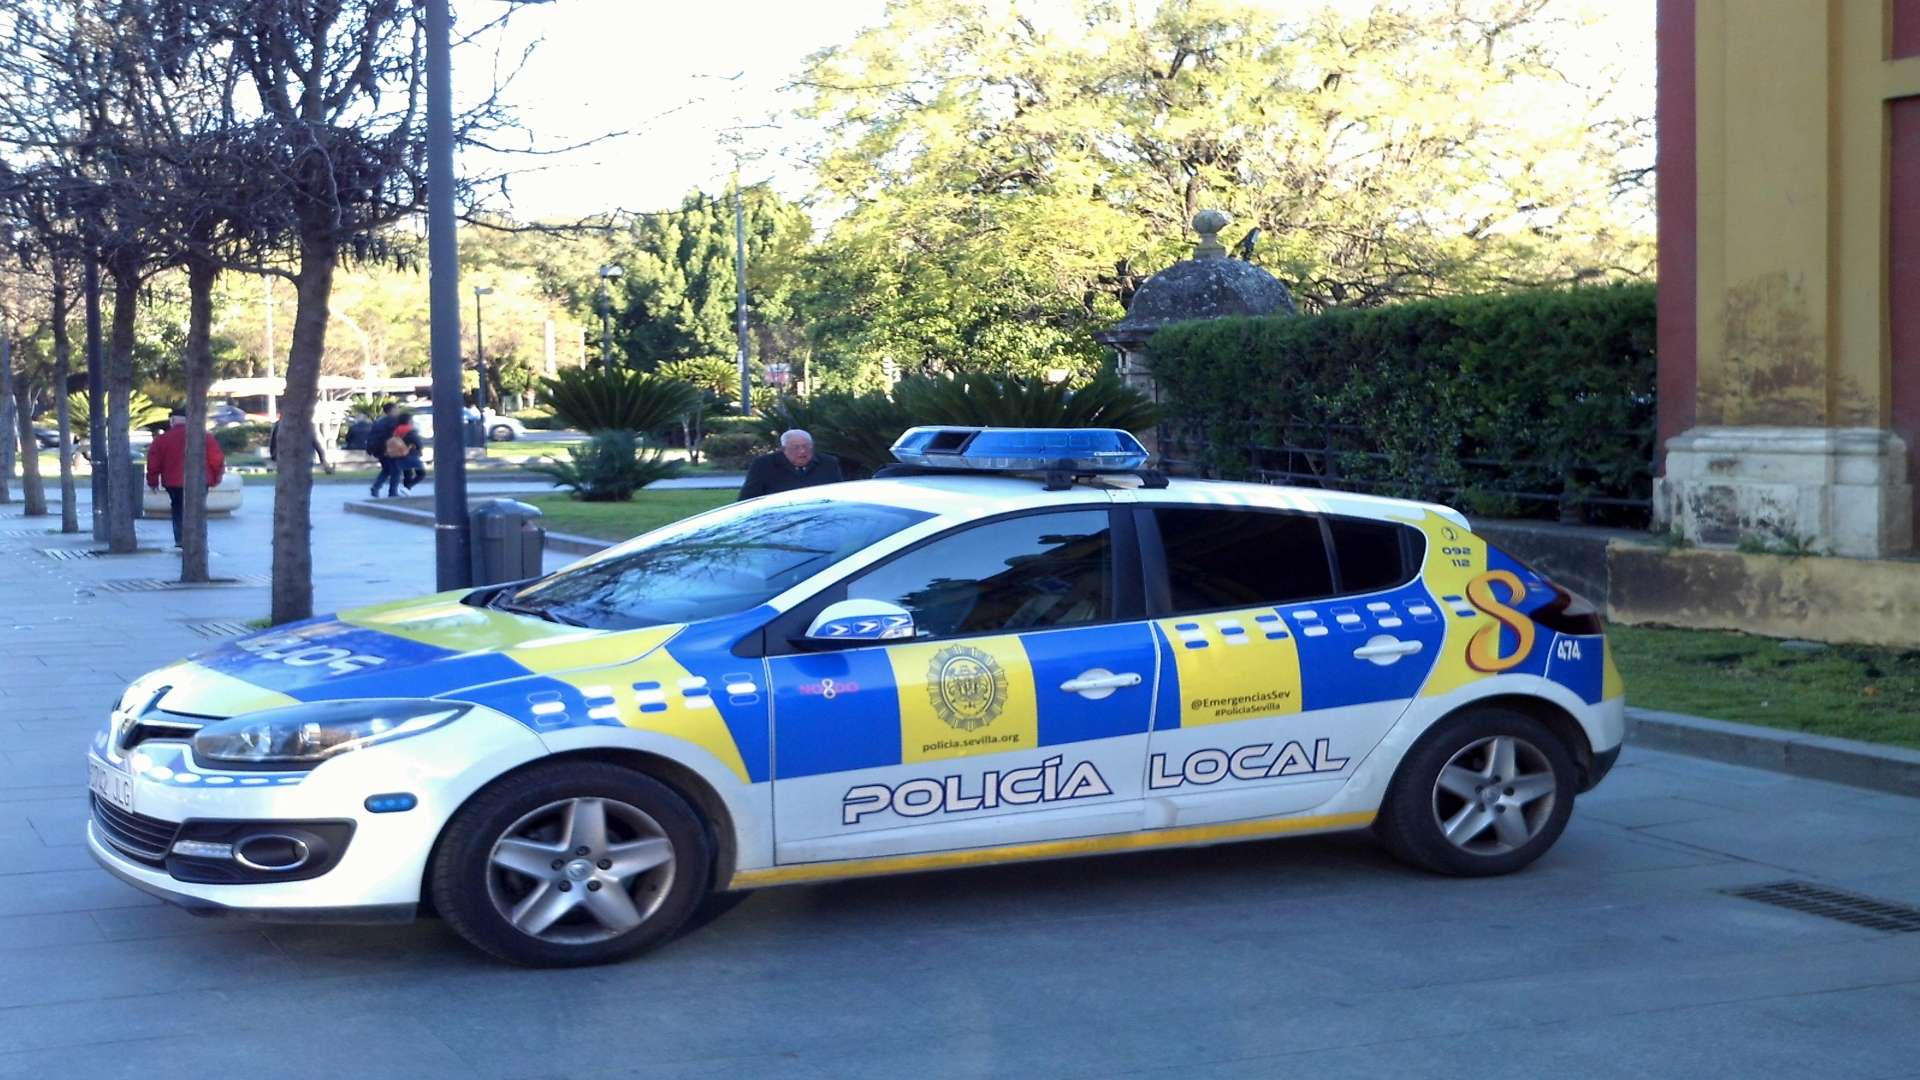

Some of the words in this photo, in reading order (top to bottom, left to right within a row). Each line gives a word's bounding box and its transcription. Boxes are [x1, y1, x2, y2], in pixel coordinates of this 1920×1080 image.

[1442, 547, 1471, 555] 092
[1452, 559, 1471, 567] 112
[1557, 640, 1581, 660] 474
[1191, 690, 1291, 711] @EmergenciasSev
[922, 733, 1020, 753] policia.sevilla.org
[842, 755, 1113, 826] POLICÍA
[1149, 737, 1351, 790] LOCAL
